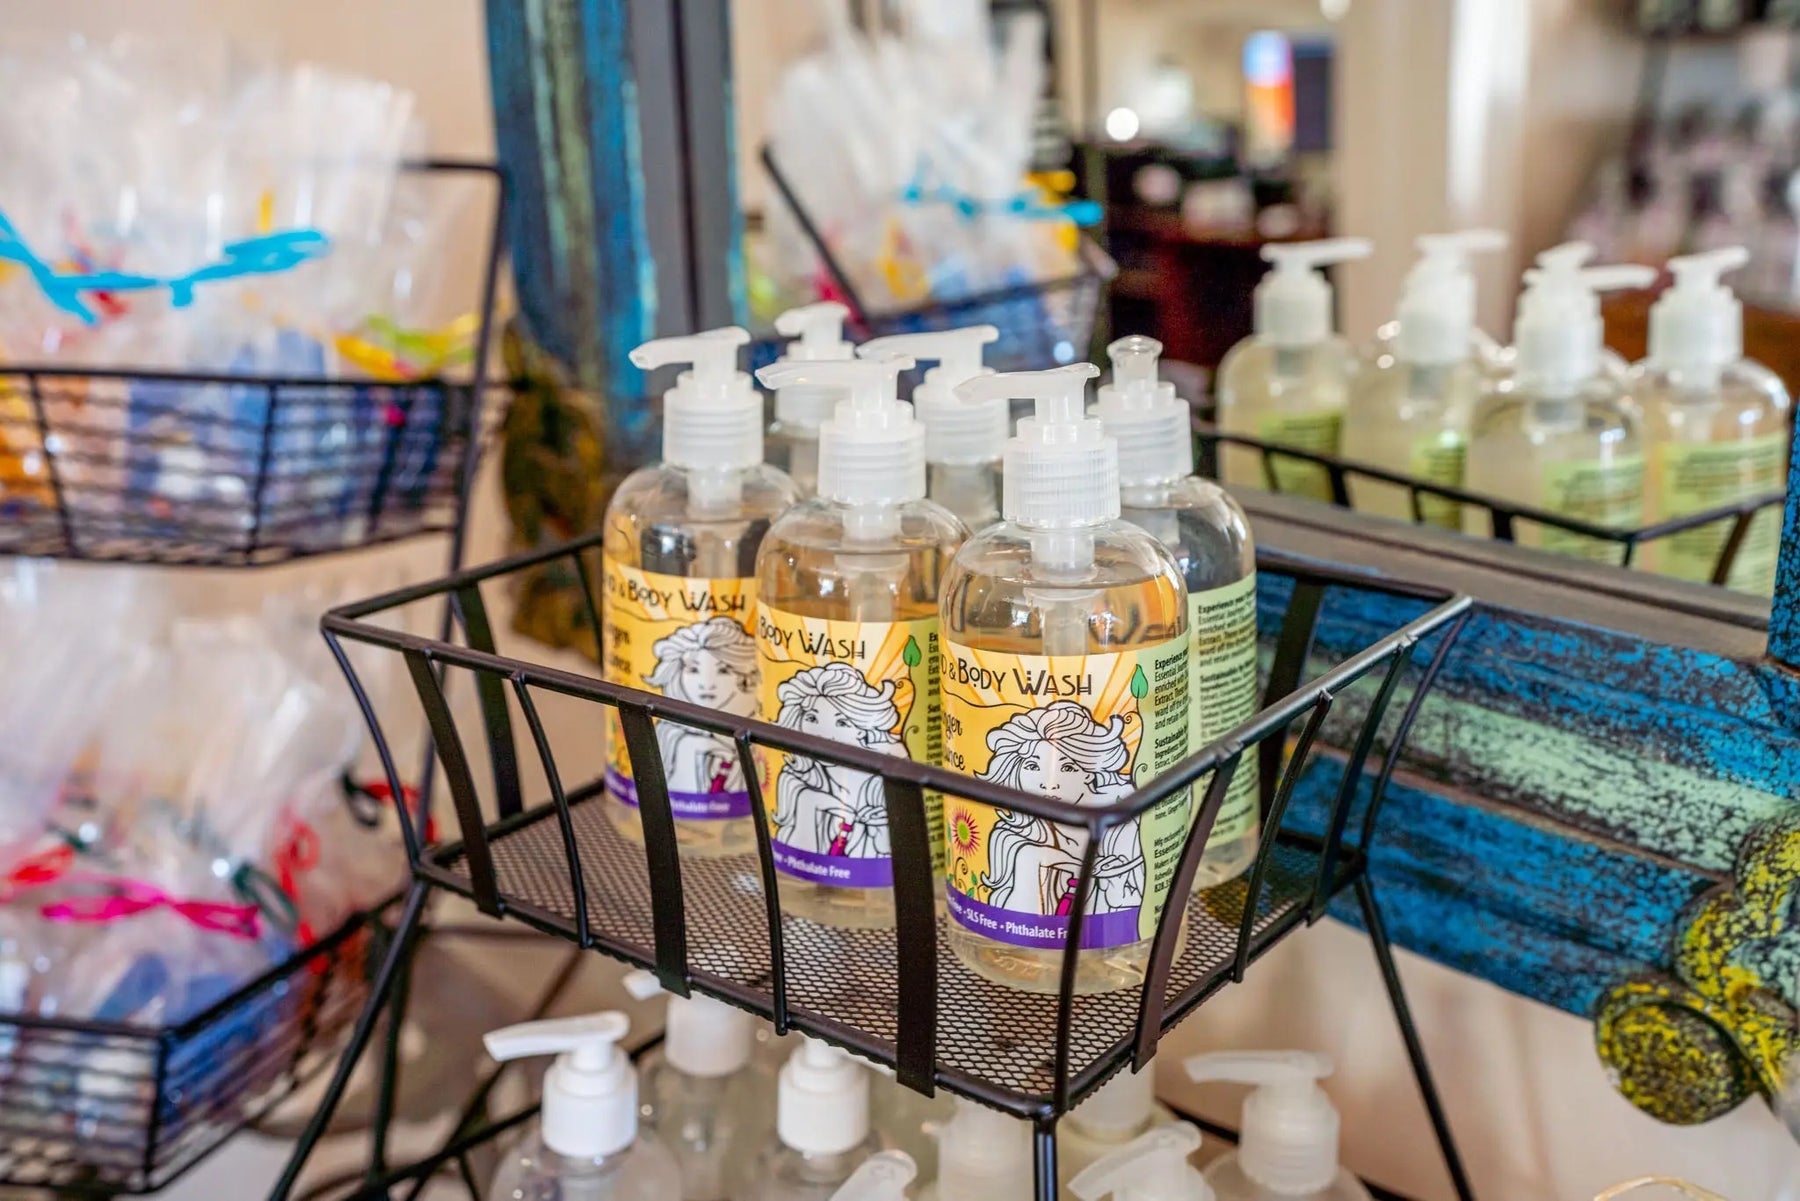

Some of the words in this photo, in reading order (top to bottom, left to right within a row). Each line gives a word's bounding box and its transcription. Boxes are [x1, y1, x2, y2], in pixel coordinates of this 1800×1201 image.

[628, 579, 673, 609] BODY
[679, 588, 746, 613] WASH
[760, 615, 793, 650] BODY
[798, 628, 866, 660] WASH
[1154, 653, 1183, 671] Experience
[949, 662, 957, 680] &
[958, 657, 1007, 693] BODY
[1012, 667, 1093, 697] WASH
[1154, 663, 1177, 683] Essential
[1154, 677, 1177, 695] enriched
[1154, 715, 1166, 730] and
[829, 864, 852, 880] Free
[966, 907, 979, 924] SLS
[980, 914, 998, 930] Free
[1005, 921, 1056, 940] Phthalate
[1057, 928, 1068, 940] Fr
